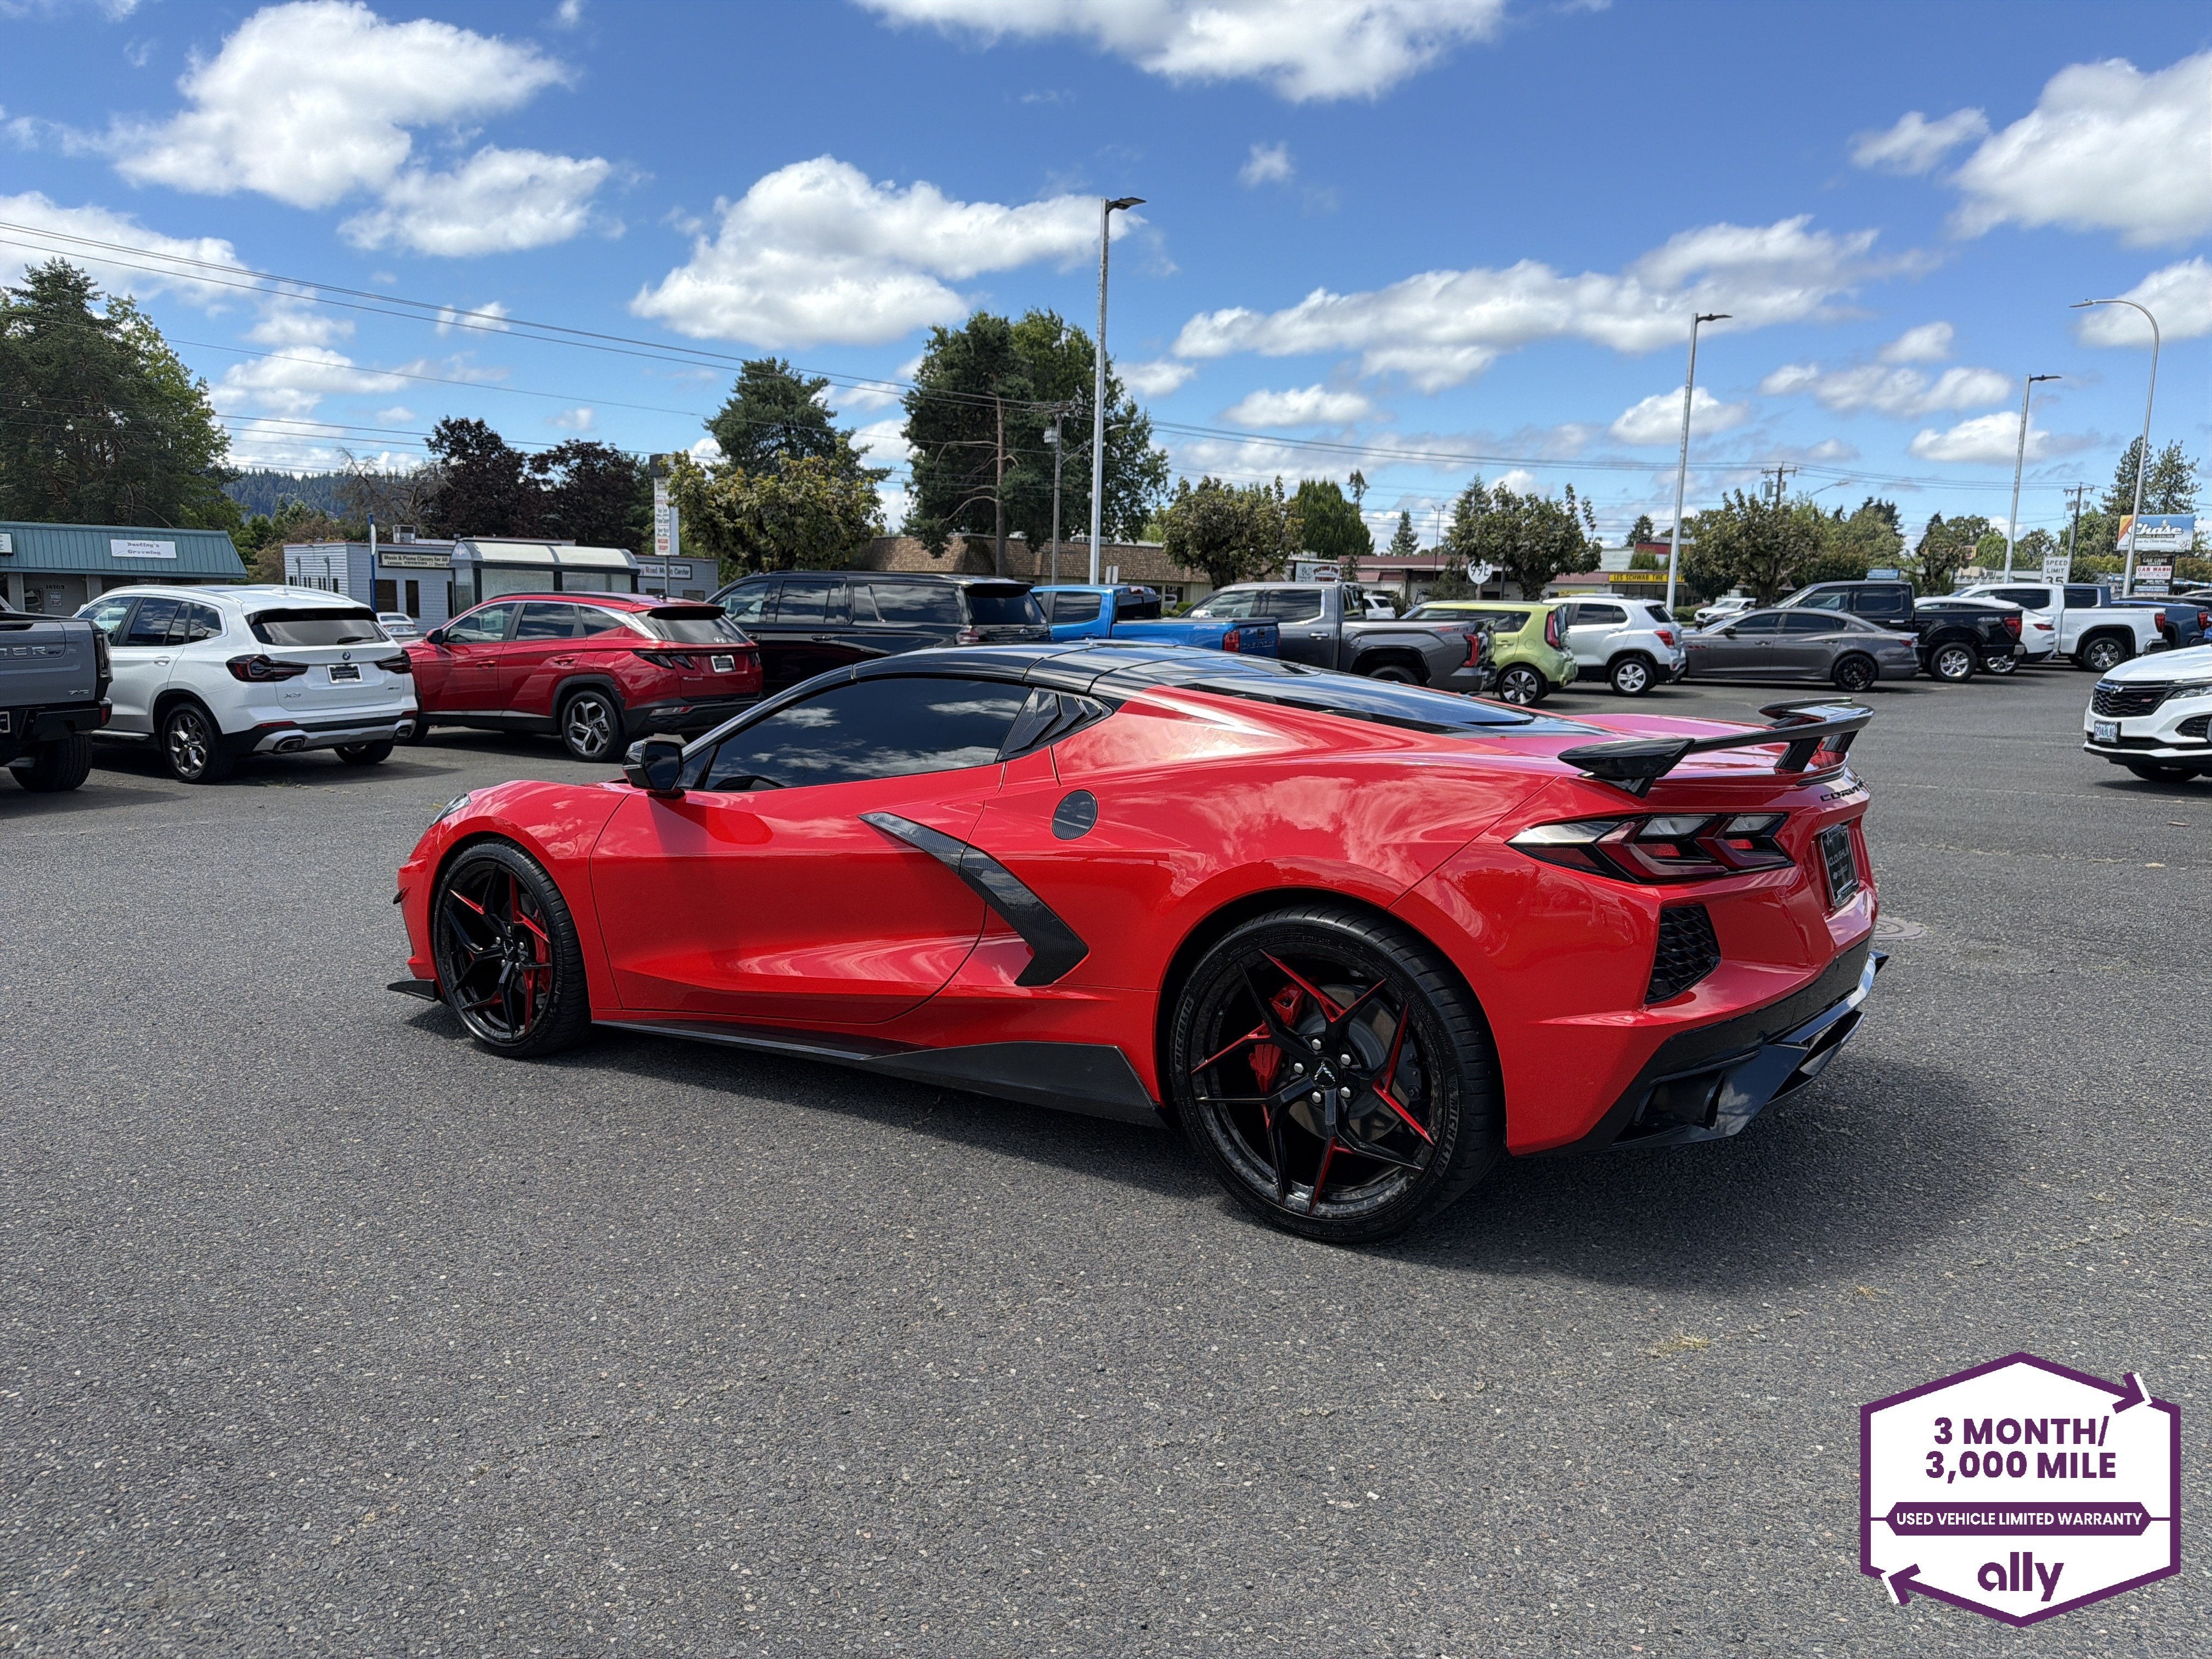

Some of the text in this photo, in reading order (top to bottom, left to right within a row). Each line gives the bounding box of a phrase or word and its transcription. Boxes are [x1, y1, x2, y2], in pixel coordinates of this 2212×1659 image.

[1471, 561, 1489, 577] 99E
[2046, 576, 2063, 584] 35
[1176, 998, 1193, 1066] MICHELIN
[1435, 1097, 1458, 1171] MICHELIN
